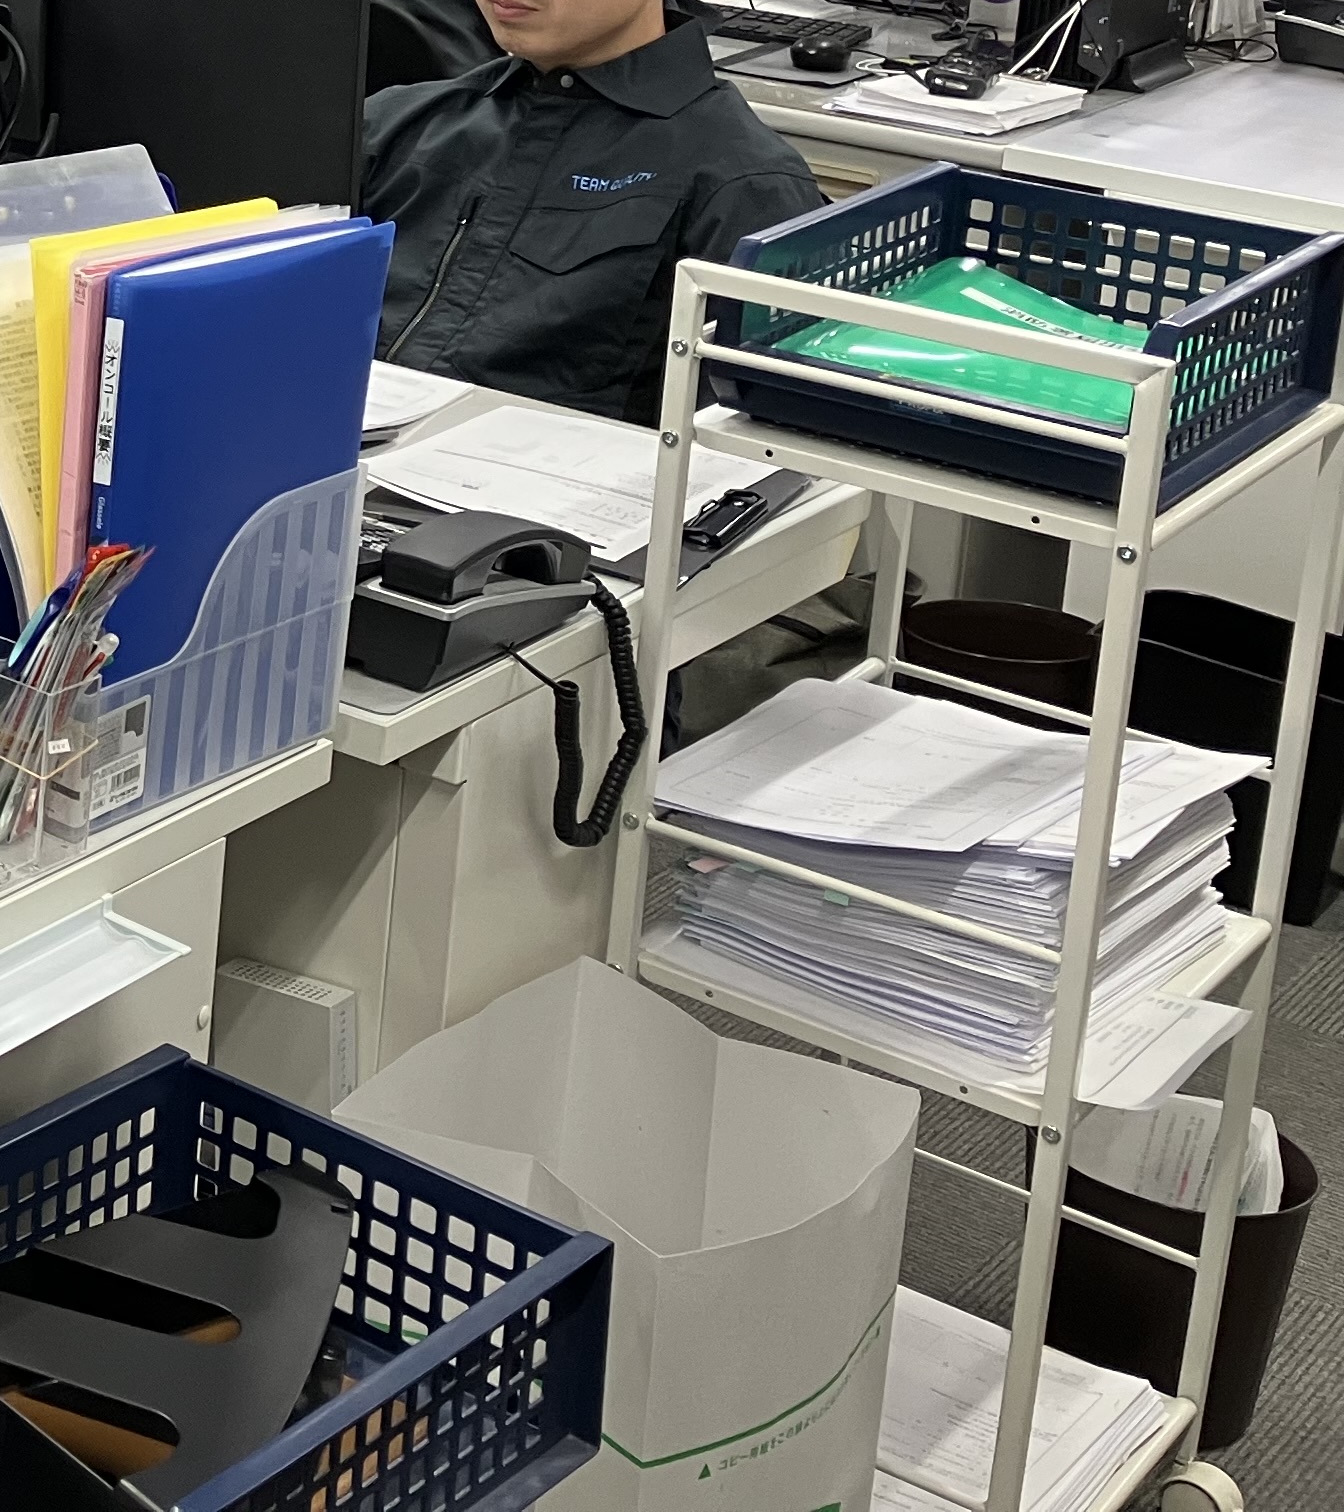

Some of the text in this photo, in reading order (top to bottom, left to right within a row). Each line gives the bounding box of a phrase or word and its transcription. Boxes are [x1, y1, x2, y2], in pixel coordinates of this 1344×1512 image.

[572, 173, 610, 192] TEAM
[98, 354, 119, 453] オンコール概要
